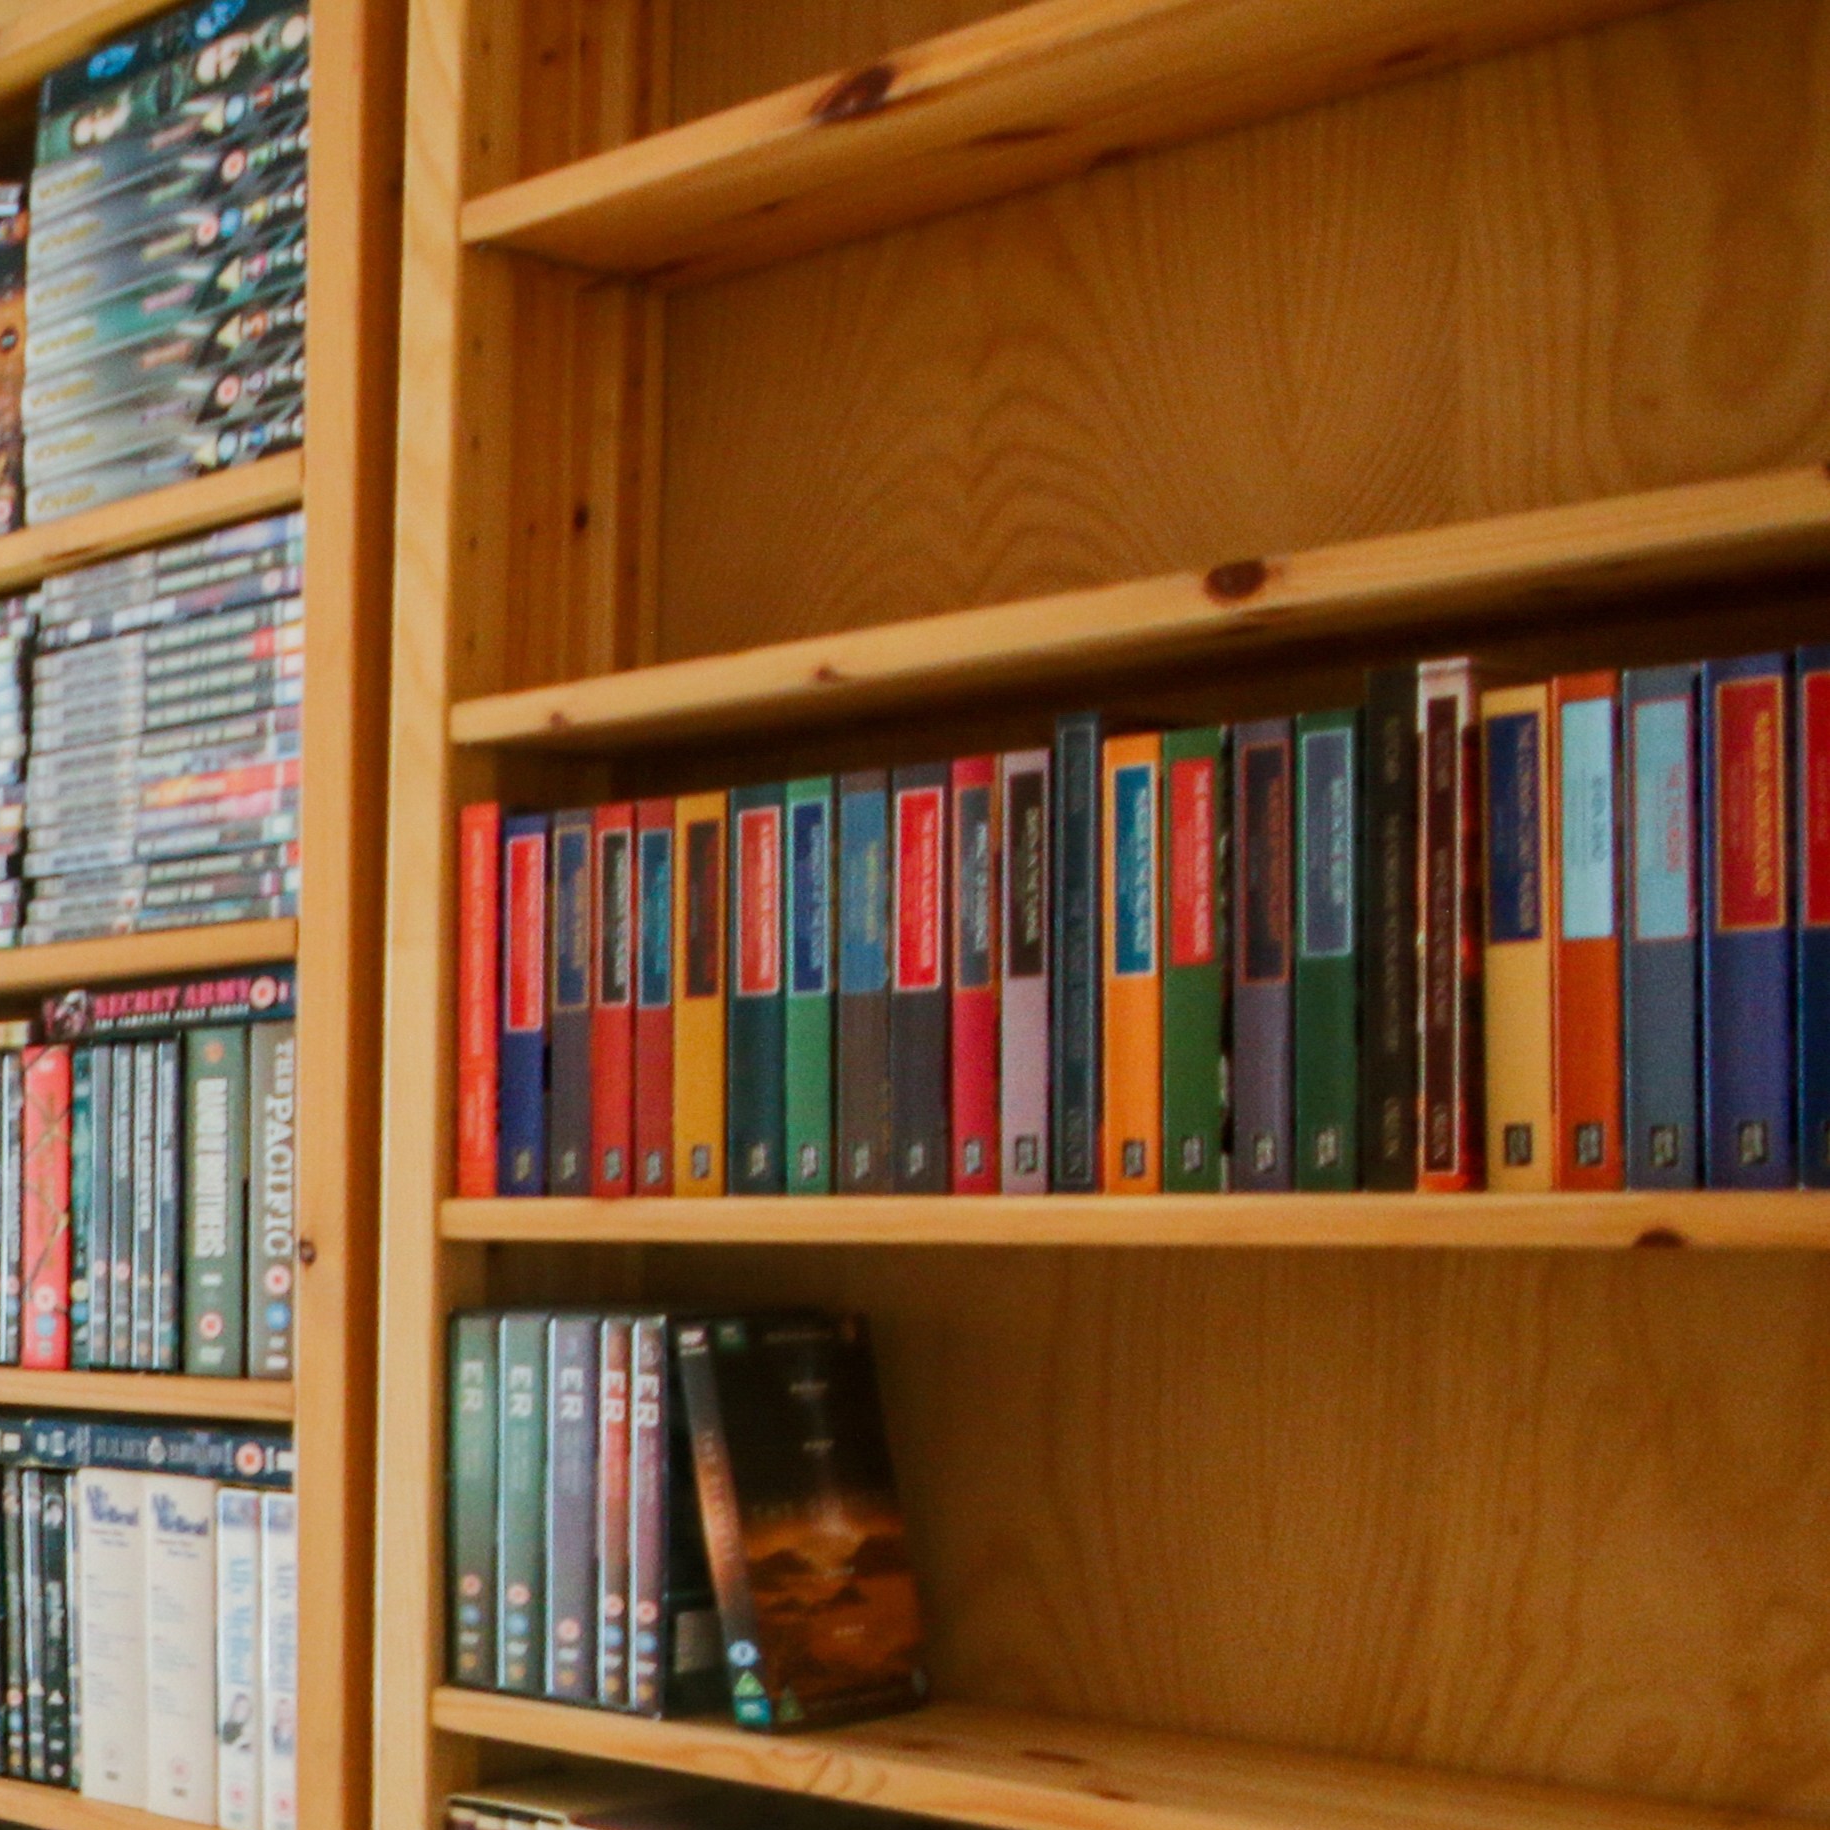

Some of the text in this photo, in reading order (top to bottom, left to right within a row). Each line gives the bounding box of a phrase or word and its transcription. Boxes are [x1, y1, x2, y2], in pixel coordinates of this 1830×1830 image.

[94, 976, 252, 1021] SECRET ARMY
[263, 1039, 295, 1257] THE PACIFIC
[460, 1360, 485, 1412] ER
[508, 1364, 533, 1419] ER
[560, 1366, 585, 1422] ER
[604, 1370, 626, 1423] ER
[637, 1374, 661, 1429] ER
